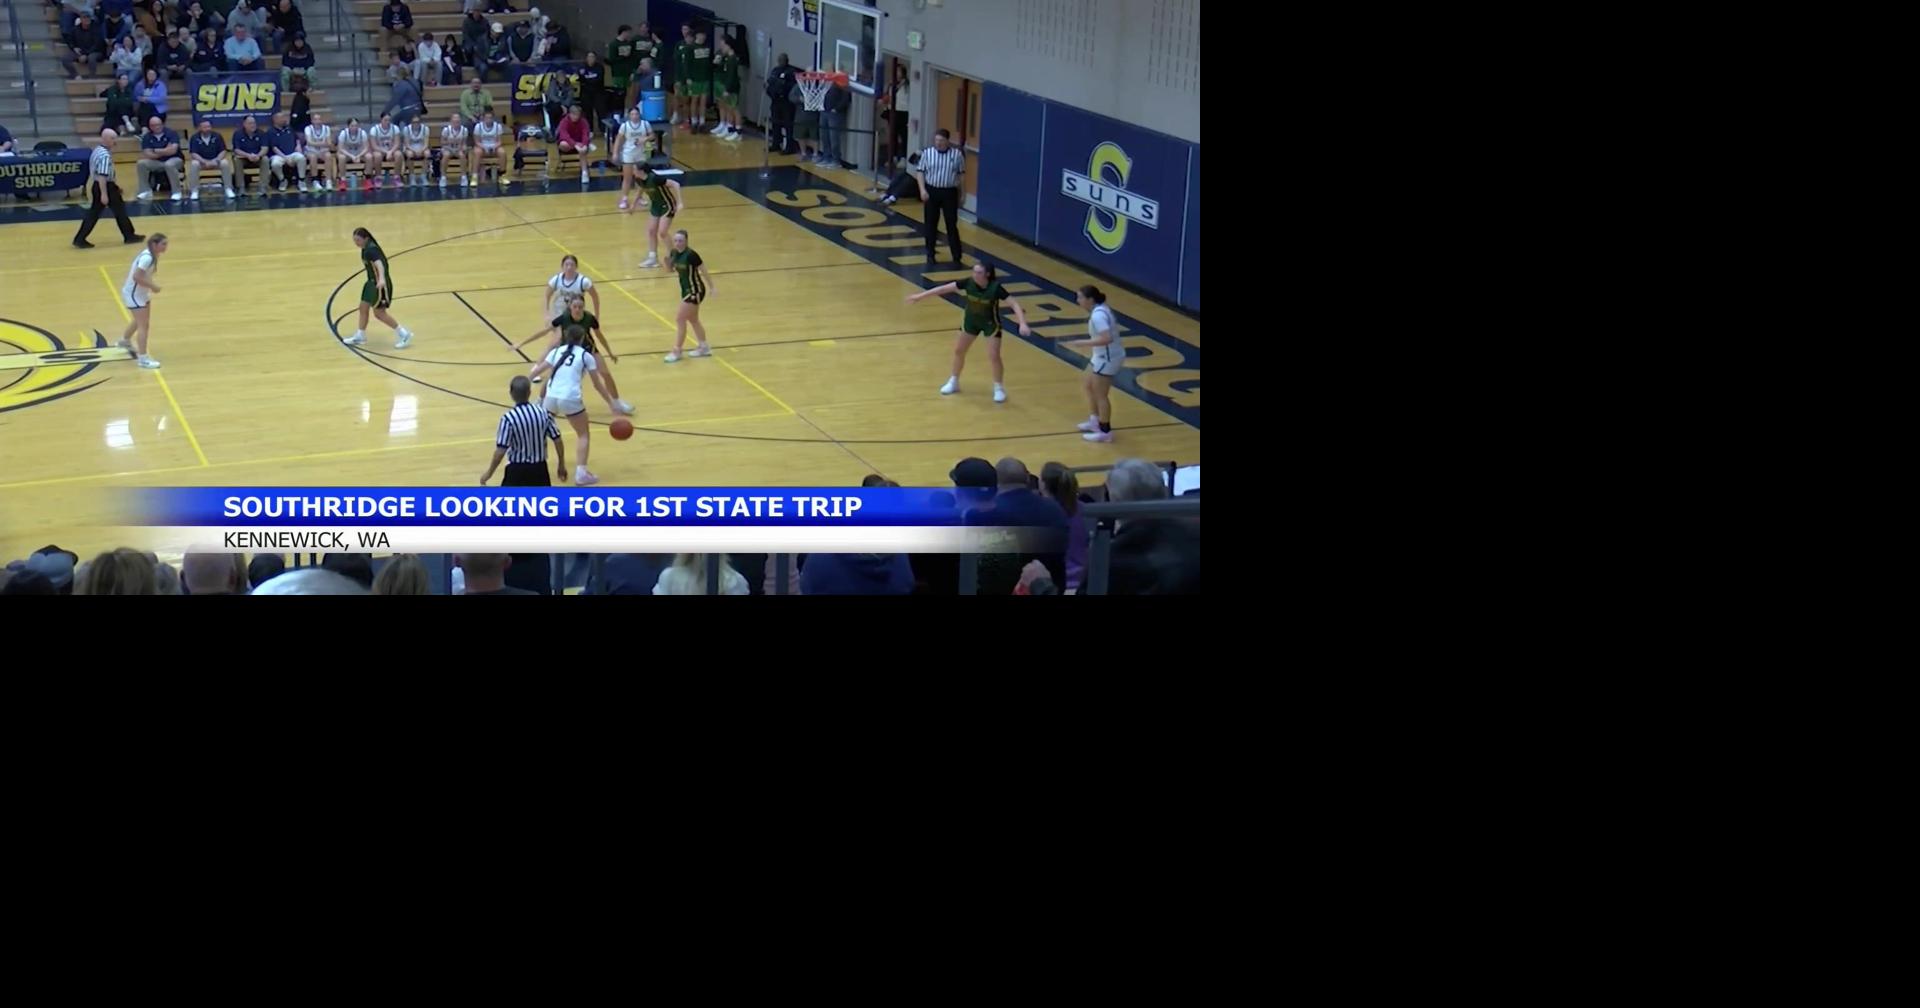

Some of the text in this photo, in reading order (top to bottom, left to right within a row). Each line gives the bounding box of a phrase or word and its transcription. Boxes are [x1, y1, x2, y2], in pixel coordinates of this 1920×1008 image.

[196, 82, 276, 112] SUNS
[15, 175, 55, 189] SUNS
[1066, 177, 1154, 220] suns
